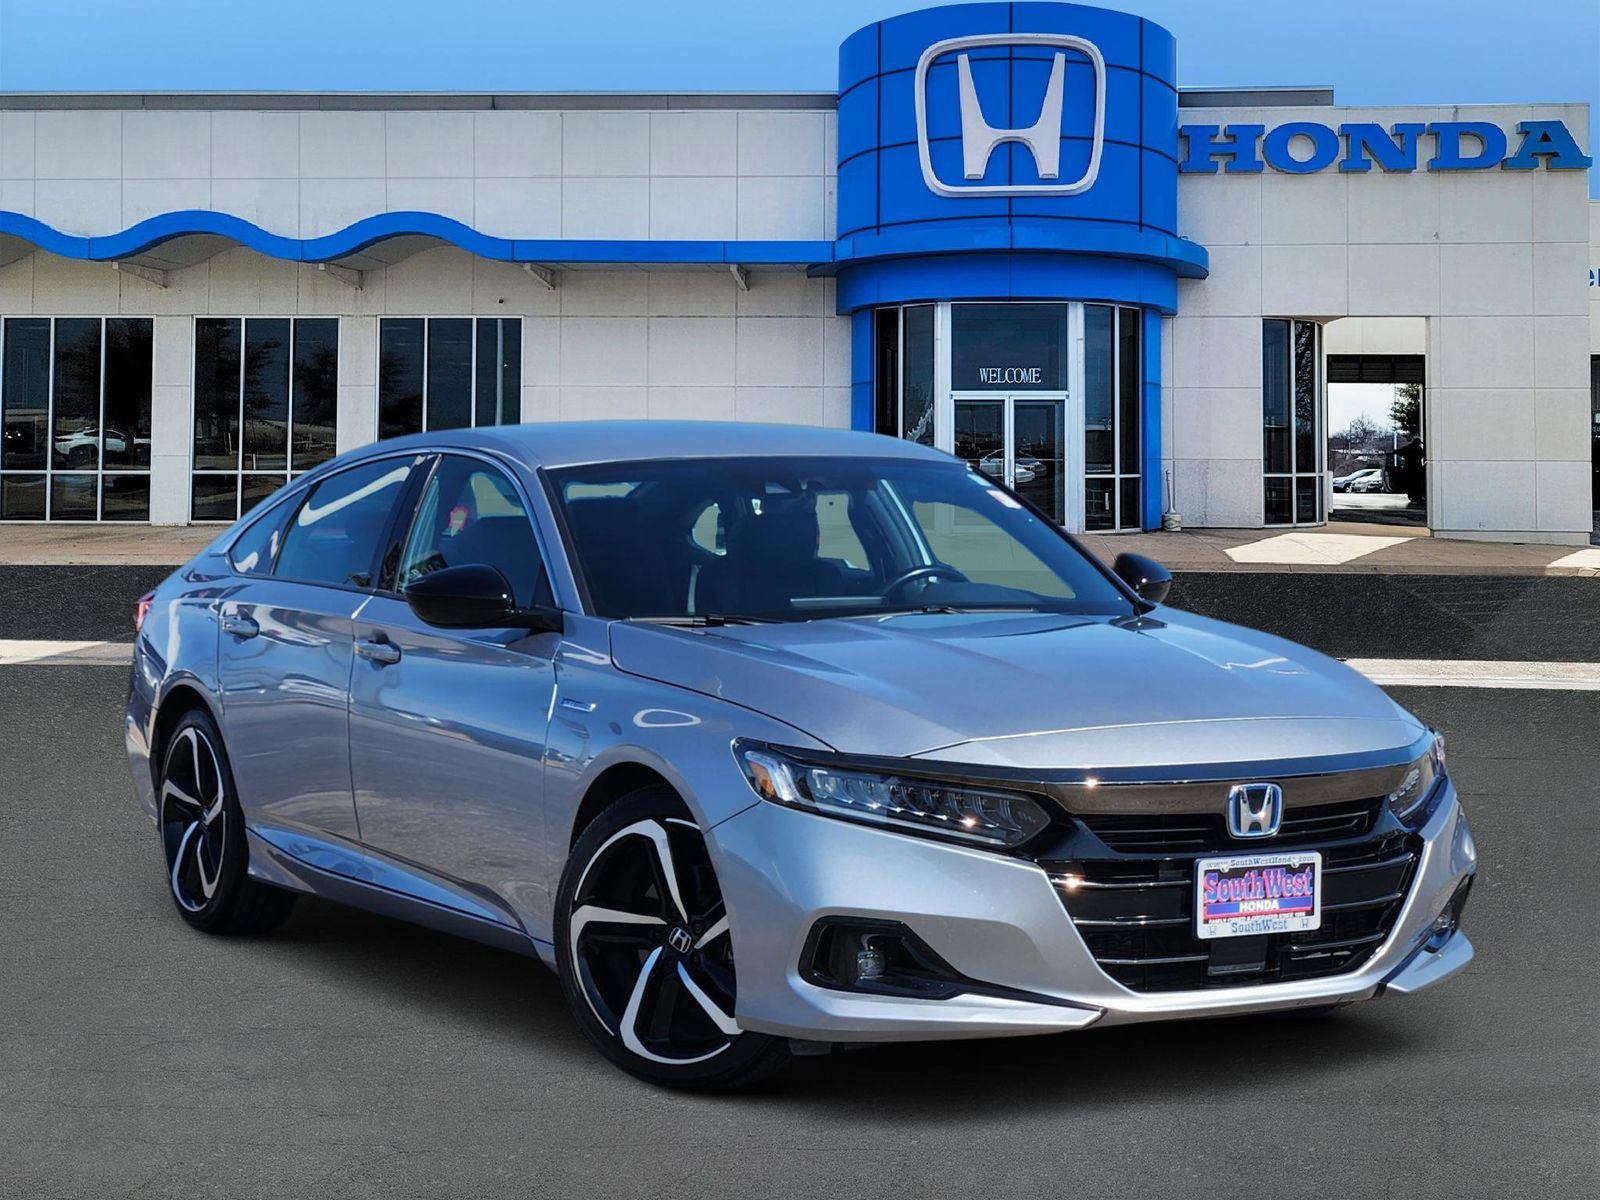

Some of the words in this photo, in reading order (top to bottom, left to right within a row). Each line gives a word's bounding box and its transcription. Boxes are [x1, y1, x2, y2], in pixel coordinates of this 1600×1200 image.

[1178, 121, 1593, 174] HONDA
[979, 367, 1042, 384] WELCOME
[1203, 866, 1313, 904] SouthWest
[1239, 899, 1280, 913] HONDA
[1231, 919, 1288, 934] SouthWest
